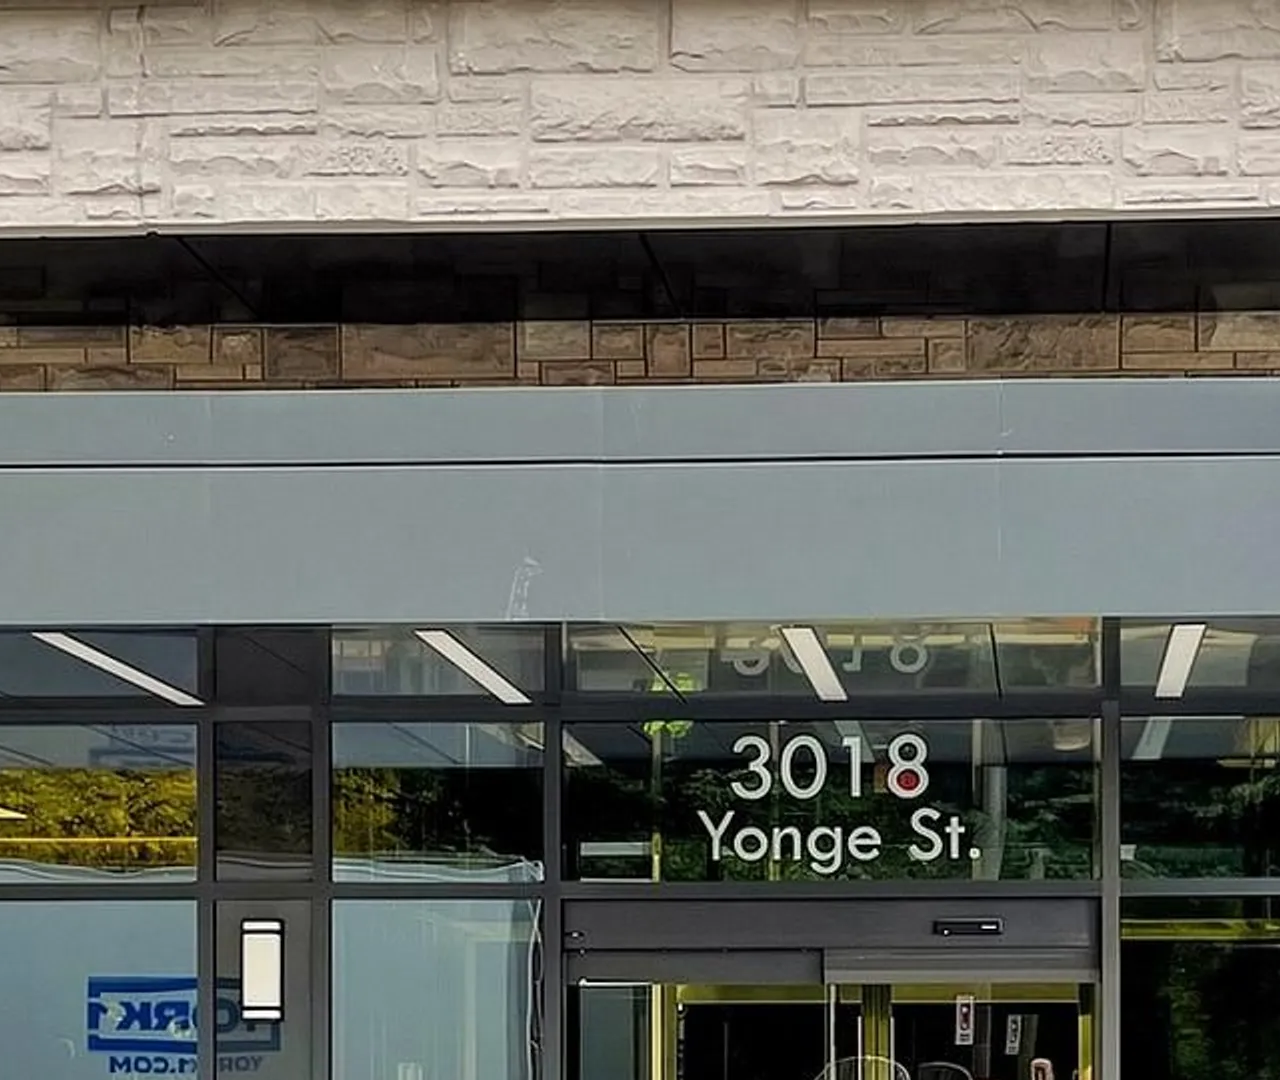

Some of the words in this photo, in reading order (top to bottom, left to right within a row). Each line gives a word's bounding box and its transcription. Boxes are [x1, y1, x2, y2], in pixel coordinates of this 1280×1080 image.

[730, 732, 930, 800] 3018
[696, 809, 882, 875] Yonge
[909, 807, 982, 861] St.
